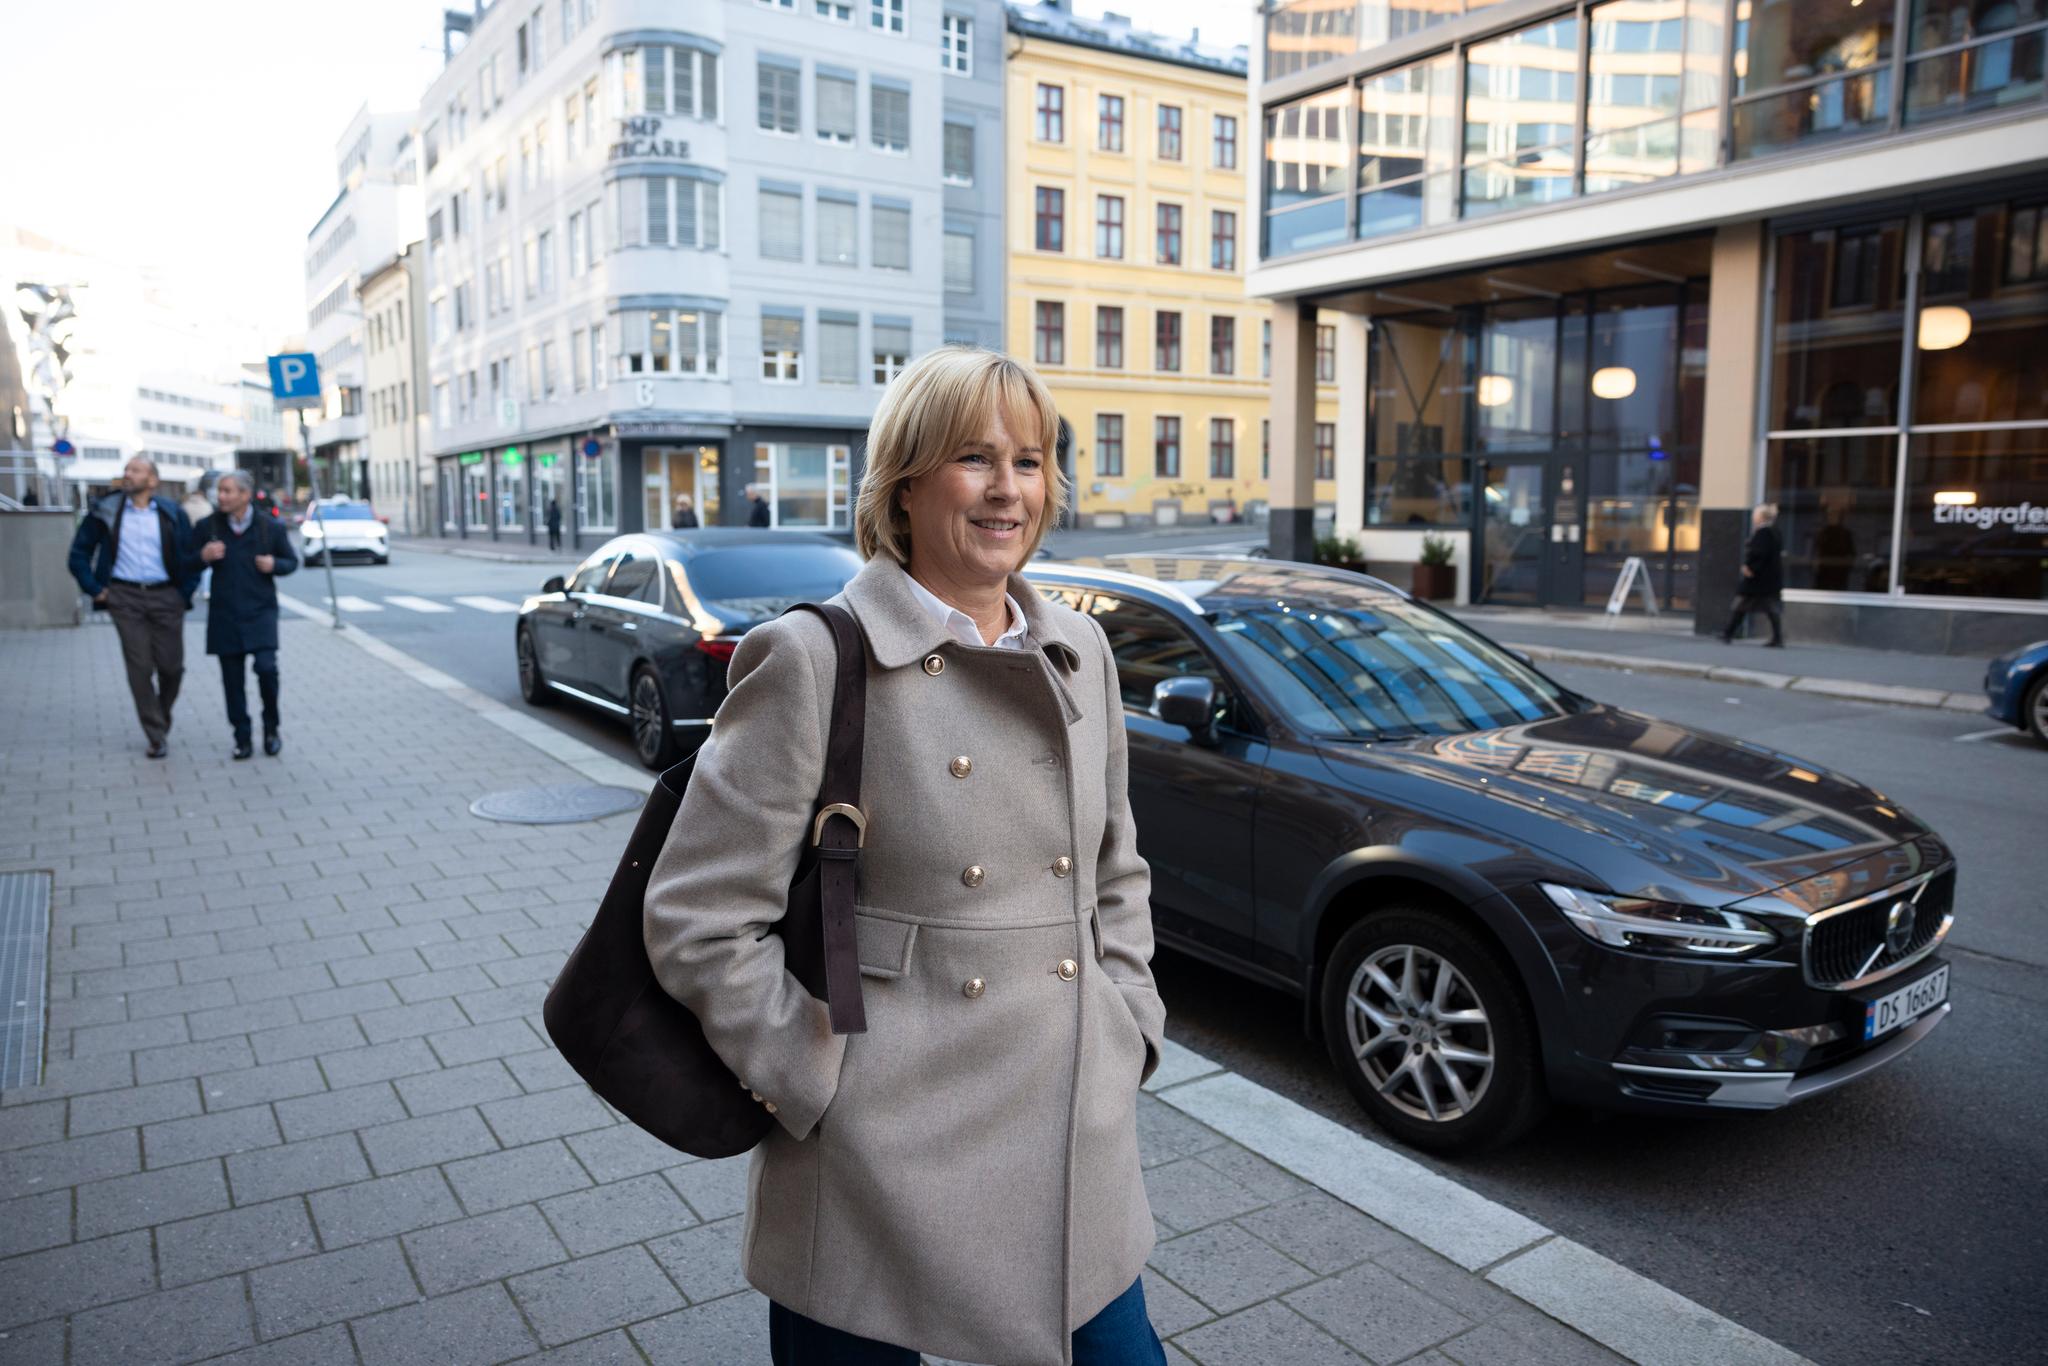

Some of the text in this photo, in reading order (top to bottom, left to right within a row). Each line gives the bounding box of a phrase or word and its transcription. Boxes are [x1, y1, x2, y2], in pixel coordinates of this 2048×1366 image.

[280, 358, 307, 393] P
[1933, 502, 2048, 530] Litografe
[1879, 971, 1945, 1029] DS 16687
